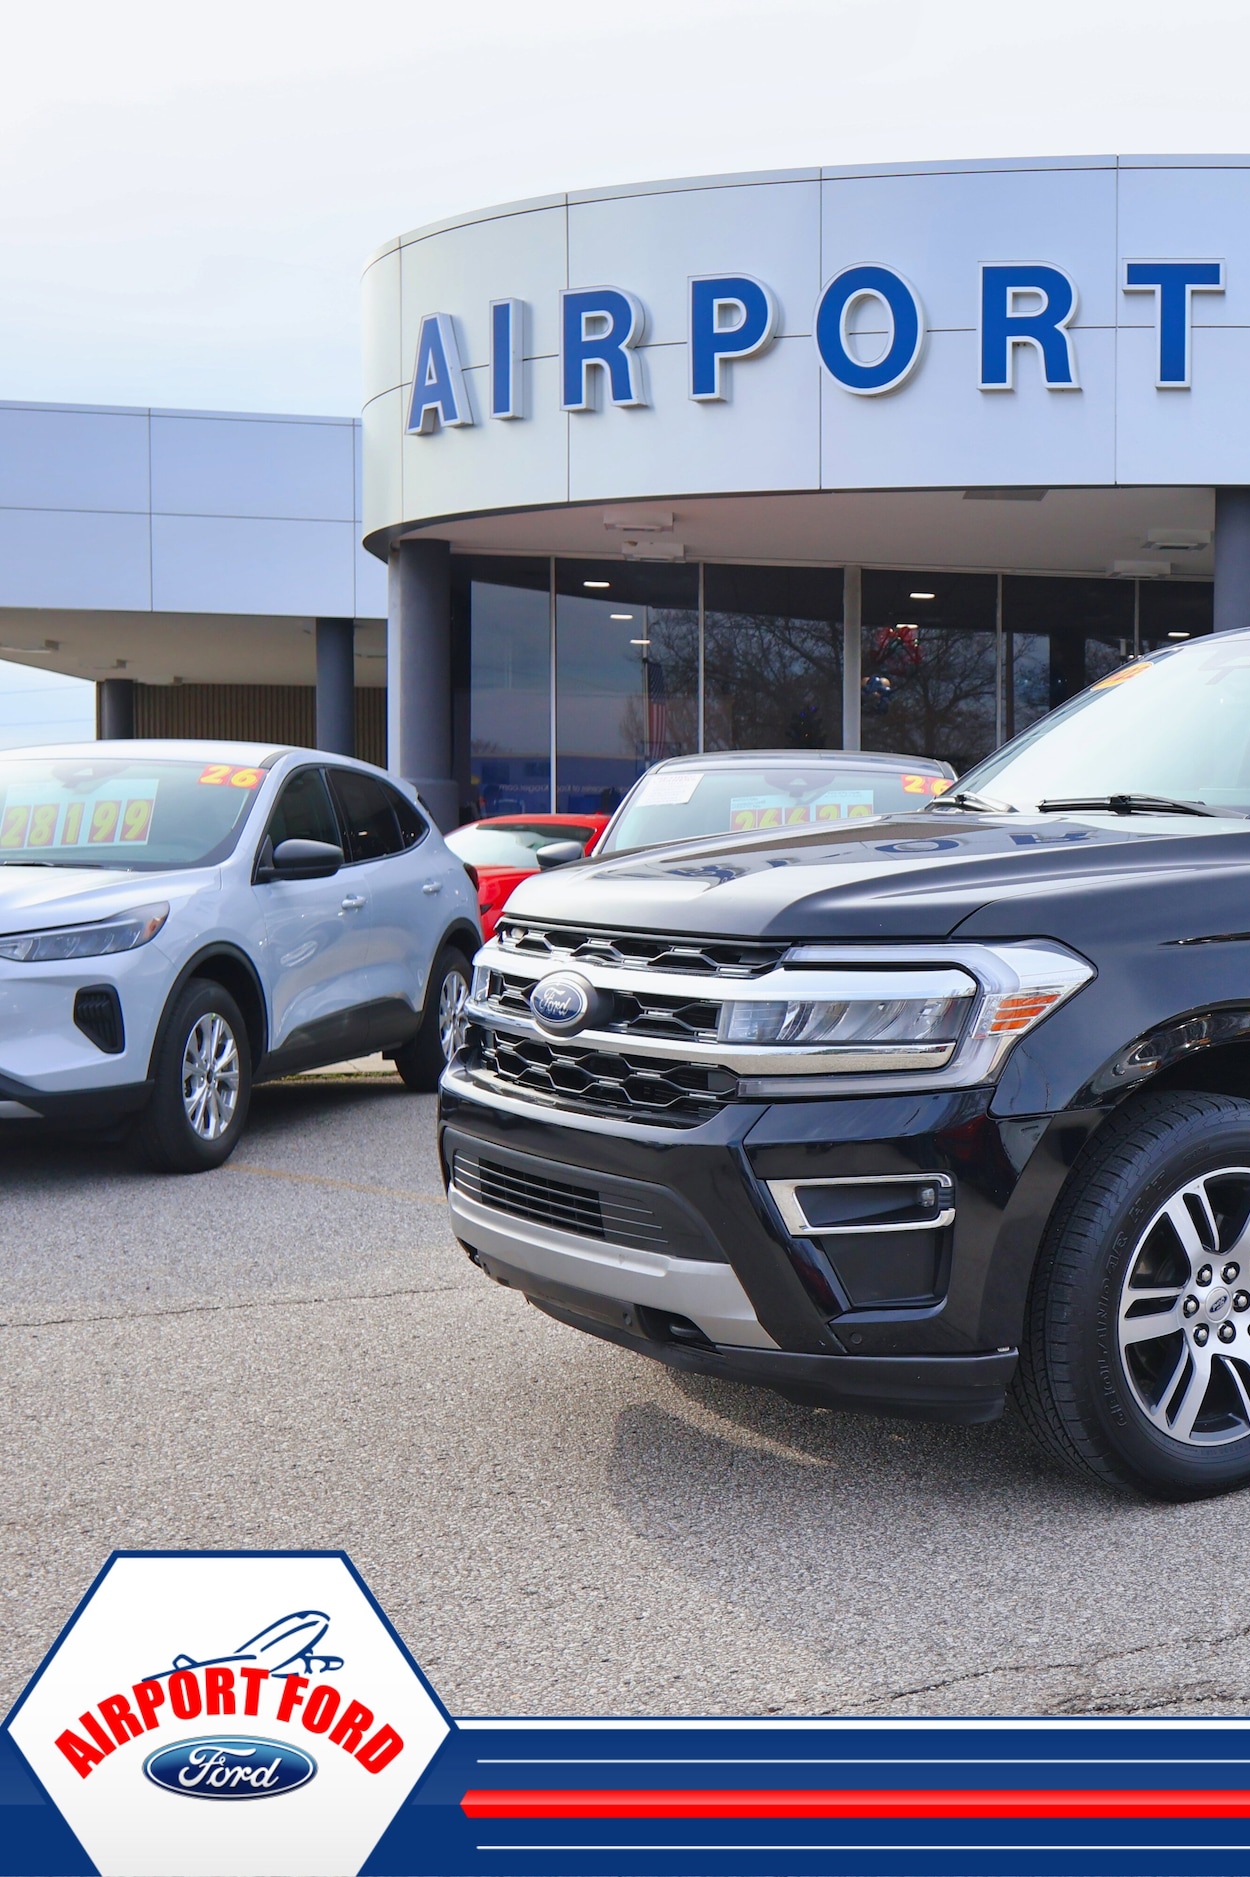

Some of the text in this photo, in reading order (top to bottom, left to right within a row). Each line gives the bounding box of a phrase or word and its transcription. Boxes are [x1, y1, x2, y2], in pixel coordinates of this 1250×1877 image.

[404, 257, 1226, 436] AIRPORT
[200, 765, 258, 788] 26
[904, 775, 949, 795] 26
[0, 802, 150, 847] 28199
[539, 987, 571, 1016] Ford
